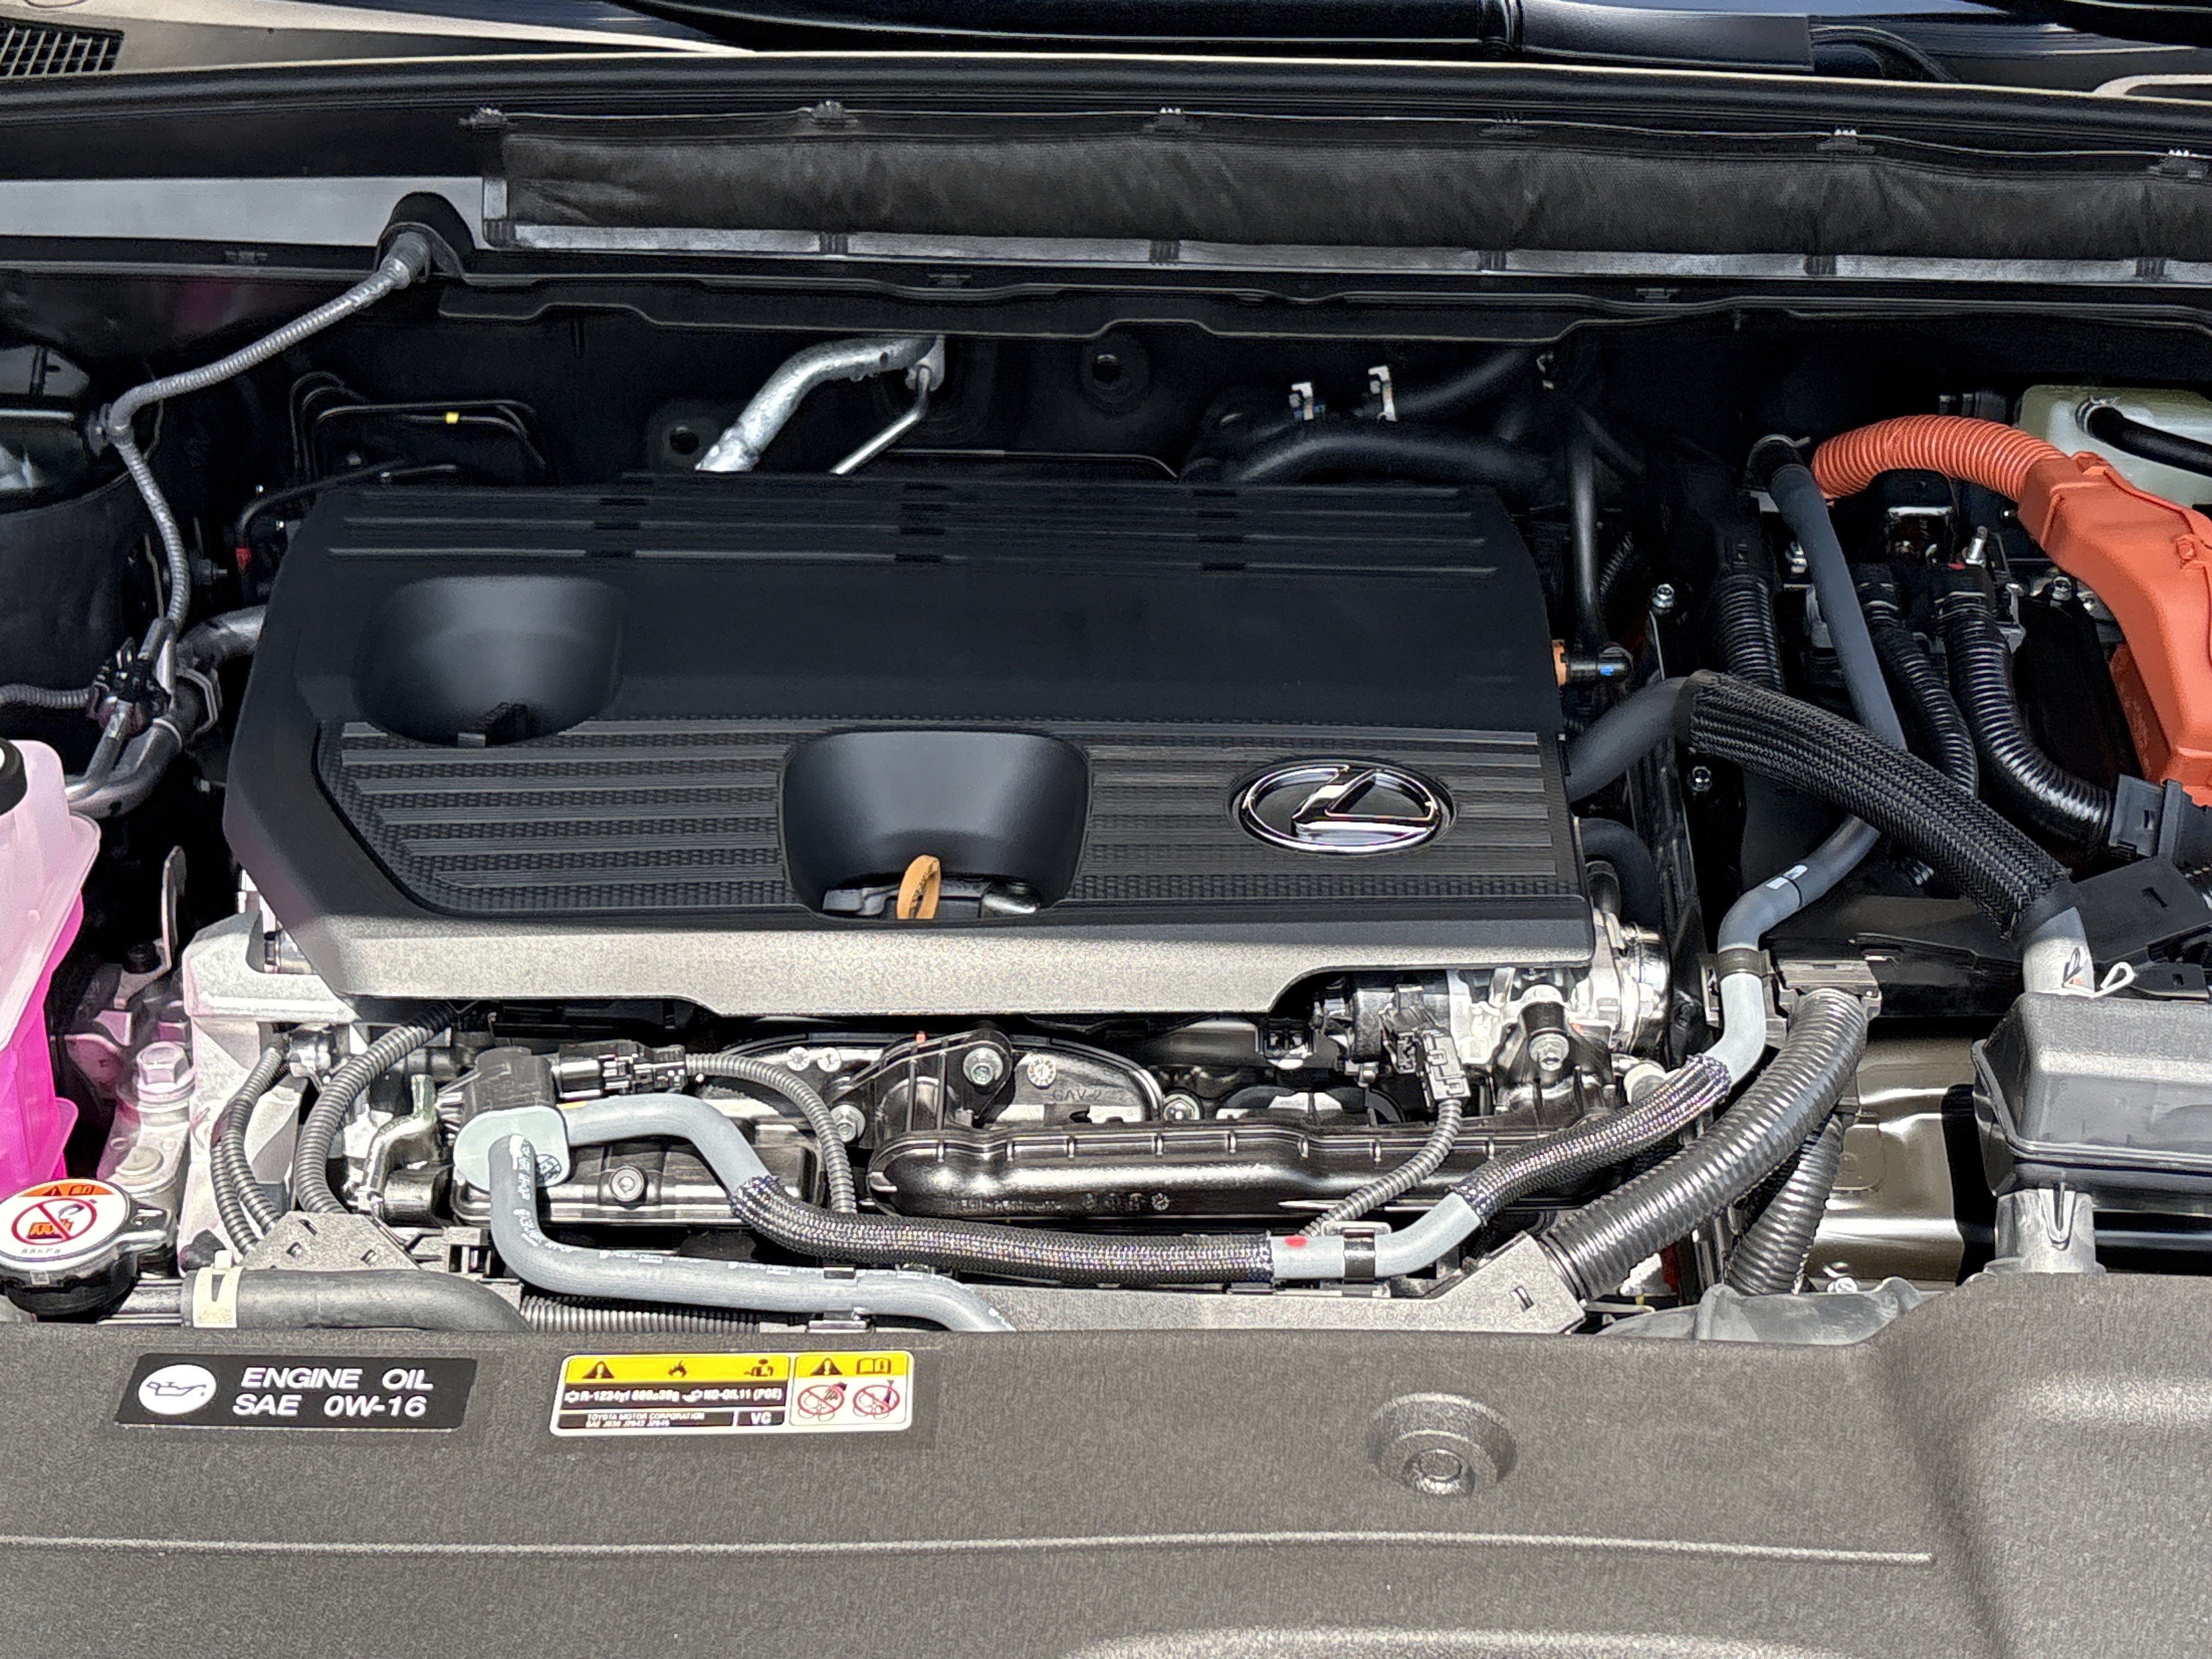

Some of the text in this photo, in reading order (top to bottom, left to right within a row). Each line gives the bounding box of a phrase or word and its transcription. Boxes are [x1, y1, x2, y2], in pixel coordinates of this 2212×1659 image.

[241, 1367, 433, 1390] ENGINE OIL
[233, 1393, 427, 1418] SAE 0W-16
[751, 1412, 772, 1425] VC
